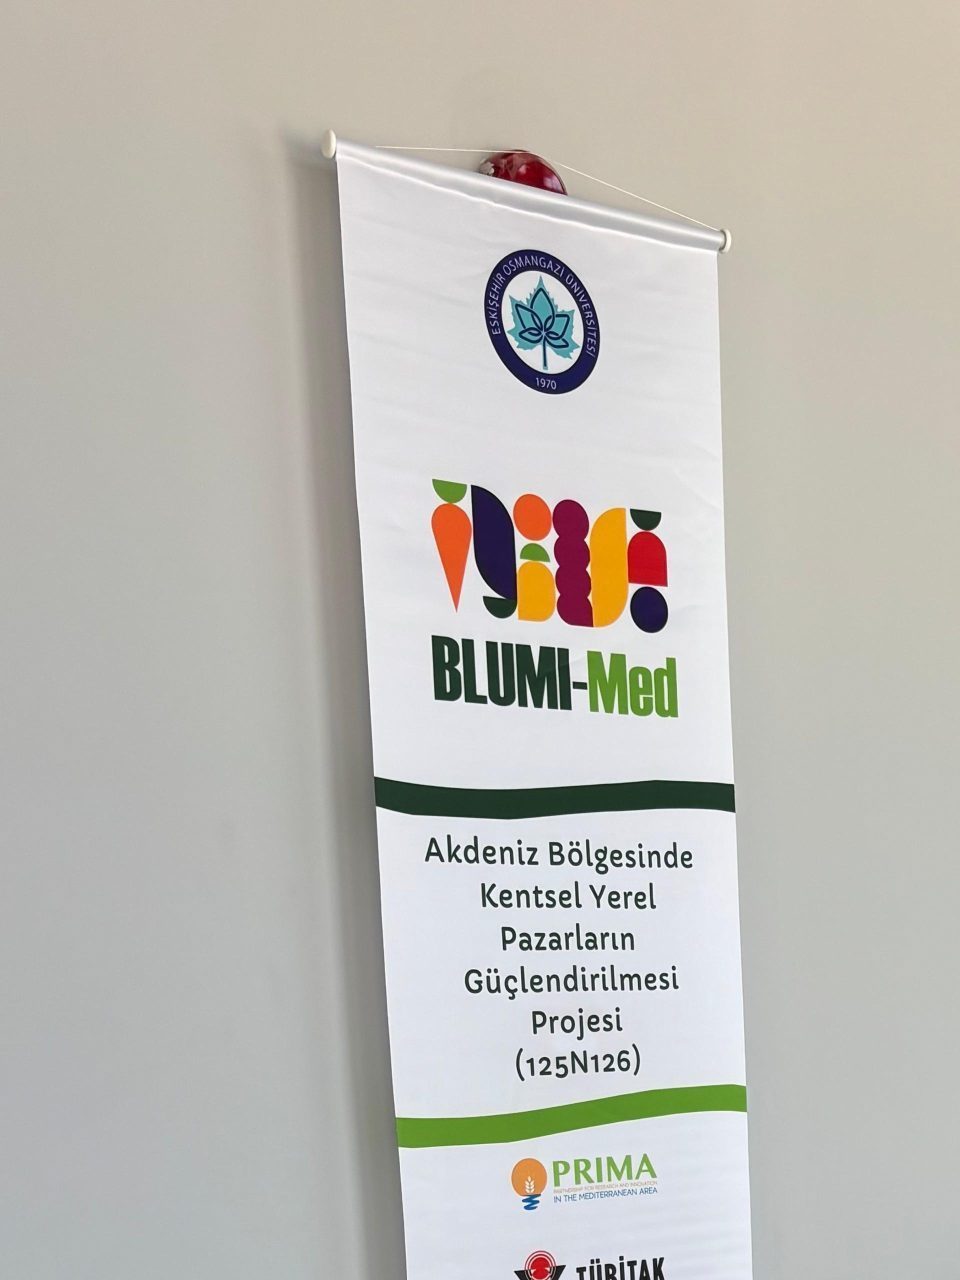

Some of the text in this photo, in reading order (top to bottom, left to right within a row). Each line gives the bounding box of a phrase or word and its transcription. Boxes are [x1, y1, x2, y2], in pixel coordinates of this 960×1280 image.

[488, 272, 505, 335] ESKİŞEHİR
[502, 255, 565, 277] OSMANGAZİ
[535, 377, 557, 390] 1970
[431, 634, 679, 718] BLUMI-Med
[424, 834, 693, 875] Akdeniz Bölgesinde
[480, 881, 657, 909] Kentsel Yerel
[500, 923, 635, 951] Pazarların
[464, 964, 679, 1000] Güçlendirilmesi
[531, 1007, 623, 1040] Projesi
[515, 1043, 641, 1081] (125N126)
[552, 1153, 657, 1187] PRIMA
[564, 1194, 577, 1202] THE
[578, 1188, 638, 1200] MEDITERRANEAN
[638, 1187, 658, 1195] AREA
